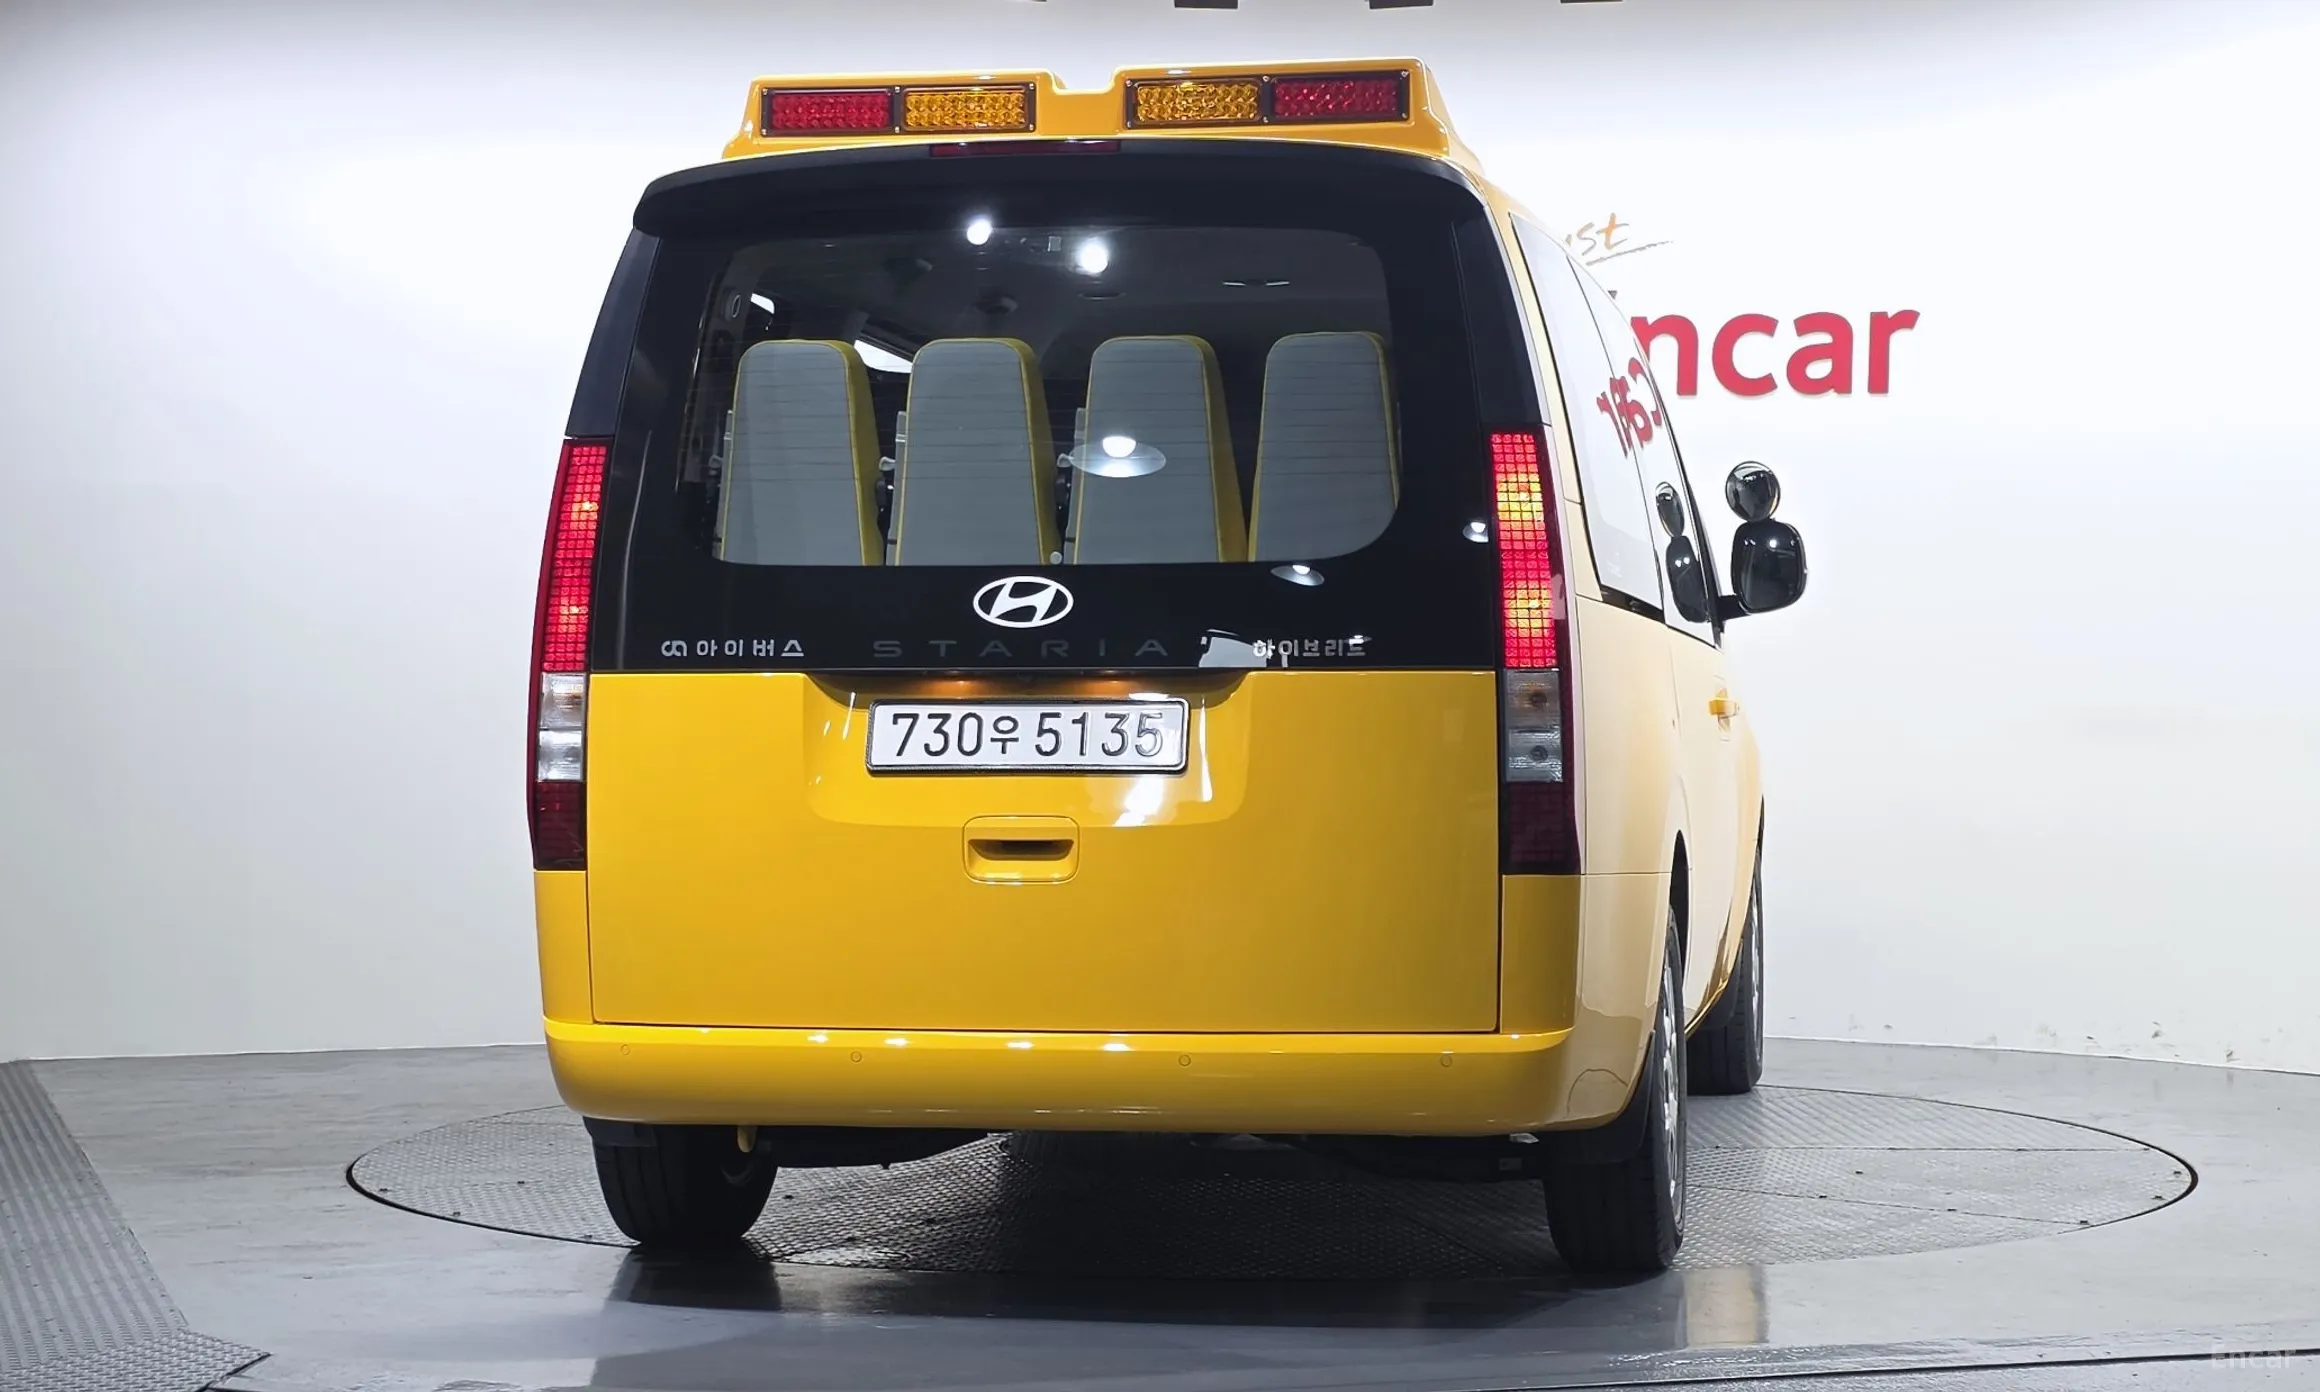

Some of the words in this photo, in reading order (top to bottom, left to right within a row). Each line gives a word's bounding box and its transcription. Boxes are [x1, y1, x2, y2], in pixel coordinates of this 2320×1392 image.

[1565, 212, 1630, 256] st
[696, 639, 804, 657] 아이버스
[873, 639, 1169, 658] STARIA
[1252, 639, 1366, 659] 하이브리드
[892, 712, 1020, 757] 730우
[1035, 711, 1163, 757] 5135
